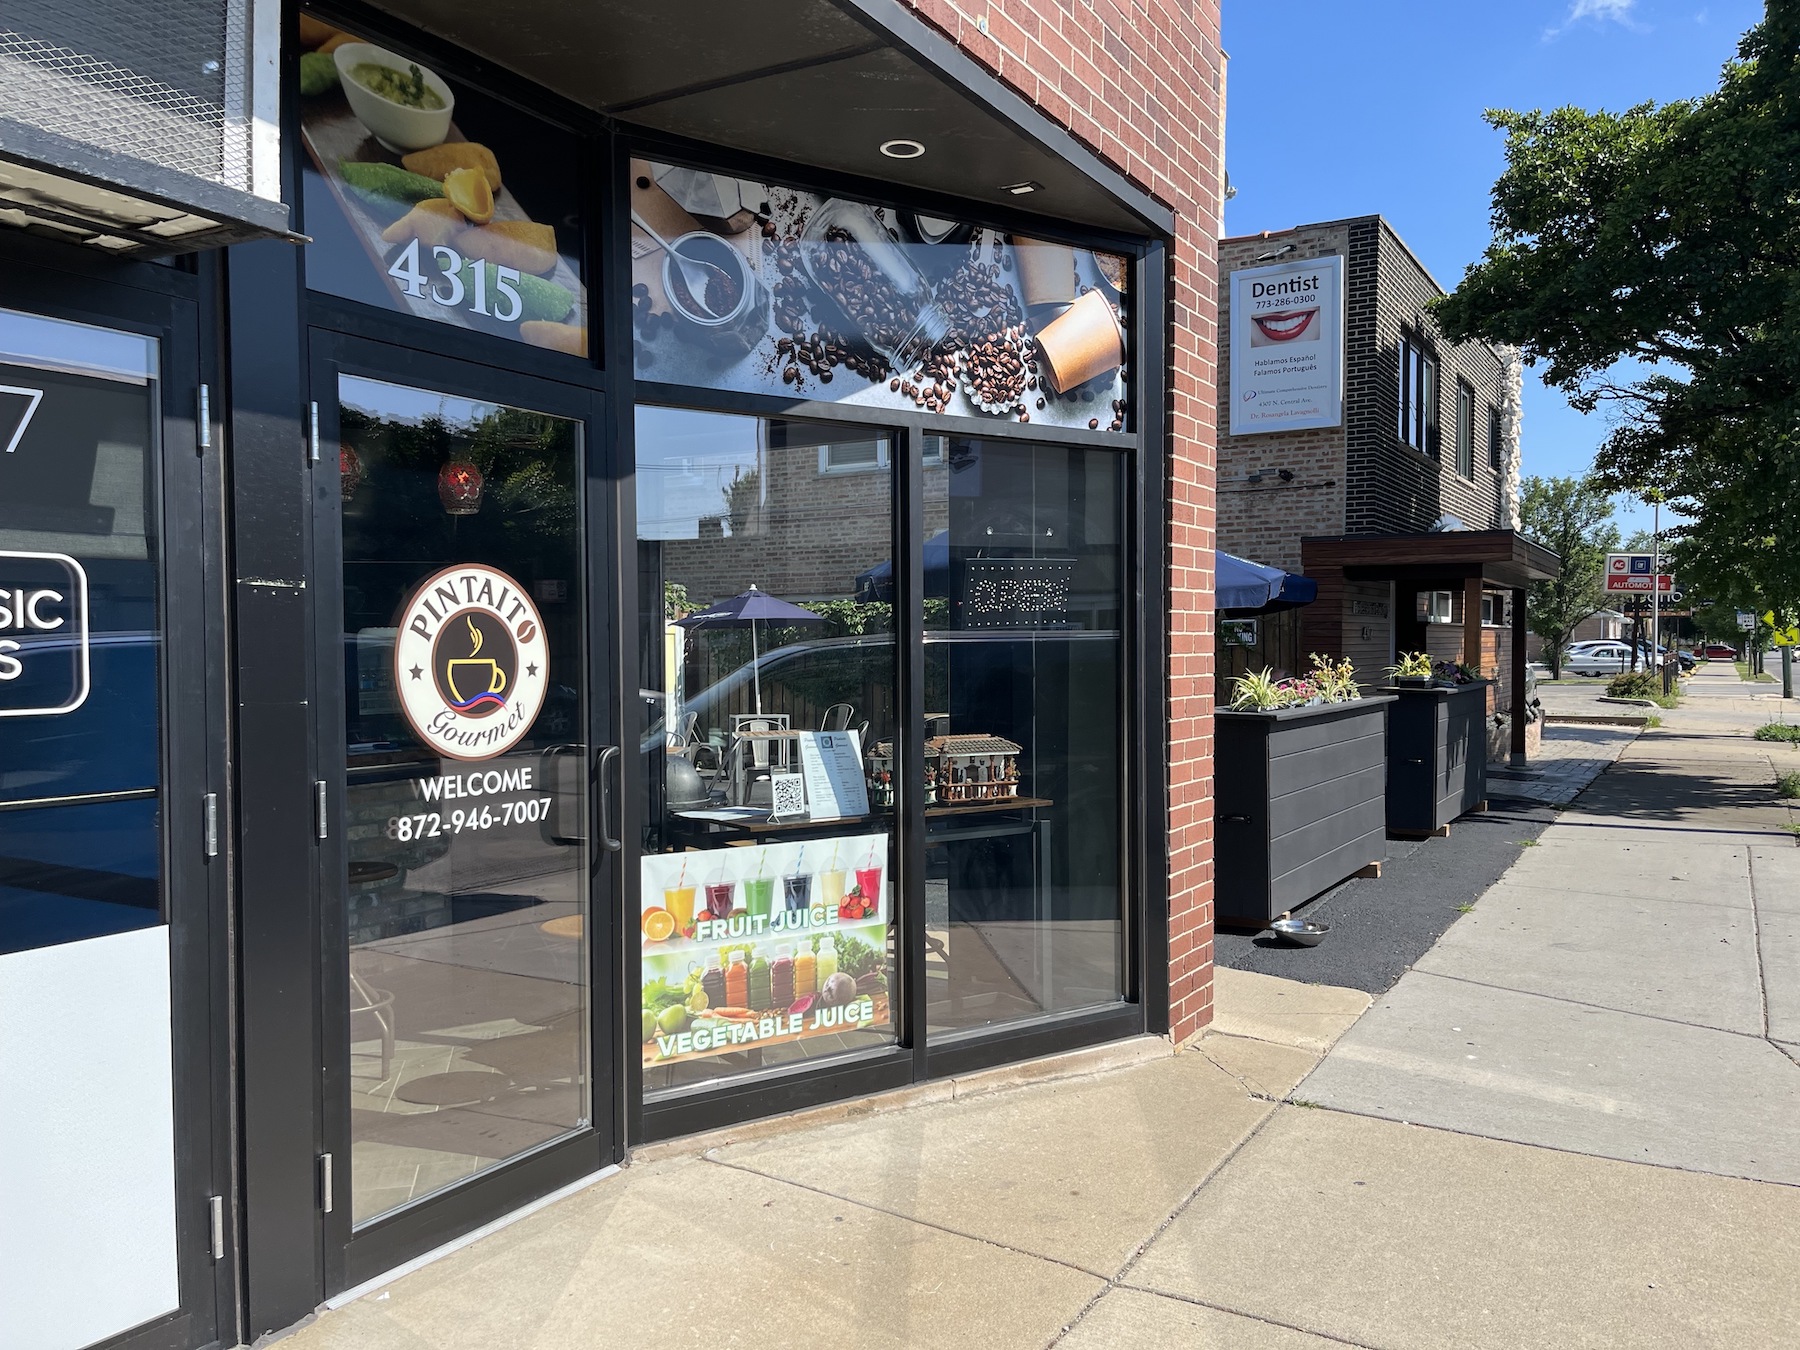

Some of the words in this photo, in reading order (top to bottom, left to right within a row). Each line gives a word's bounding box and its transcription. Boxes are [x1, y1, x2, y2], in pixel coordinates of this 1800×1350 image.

[388, 237, 523, 322] 4315
[1252, 275, 1320, 298] Dentist
[1256, 294, 1316, 310] 773-286-0300
[1253, 368, 1281, 377] Falamos
[1282, 364, 1317, 374] Português
[1254, 358, 1288, 367] Hablamos
[1289, 354, 1316, 364] Español
[974, 579, 1065, 613] OPEN
[1612, 581, 1666, 589] AUTOMOTE
[426, 700, 526, 747] Gourmet
[420, 766, 532, 803] WELCOME
[398, 797, 552, 842] 872-946-7007
[696, 913, 768, 943] FRUIT
[772, 904, 840, 932] JUICE
[657, 1013, 804, 1057] VEGETABLE
[809, 1000, 874, 1030] JUICE
